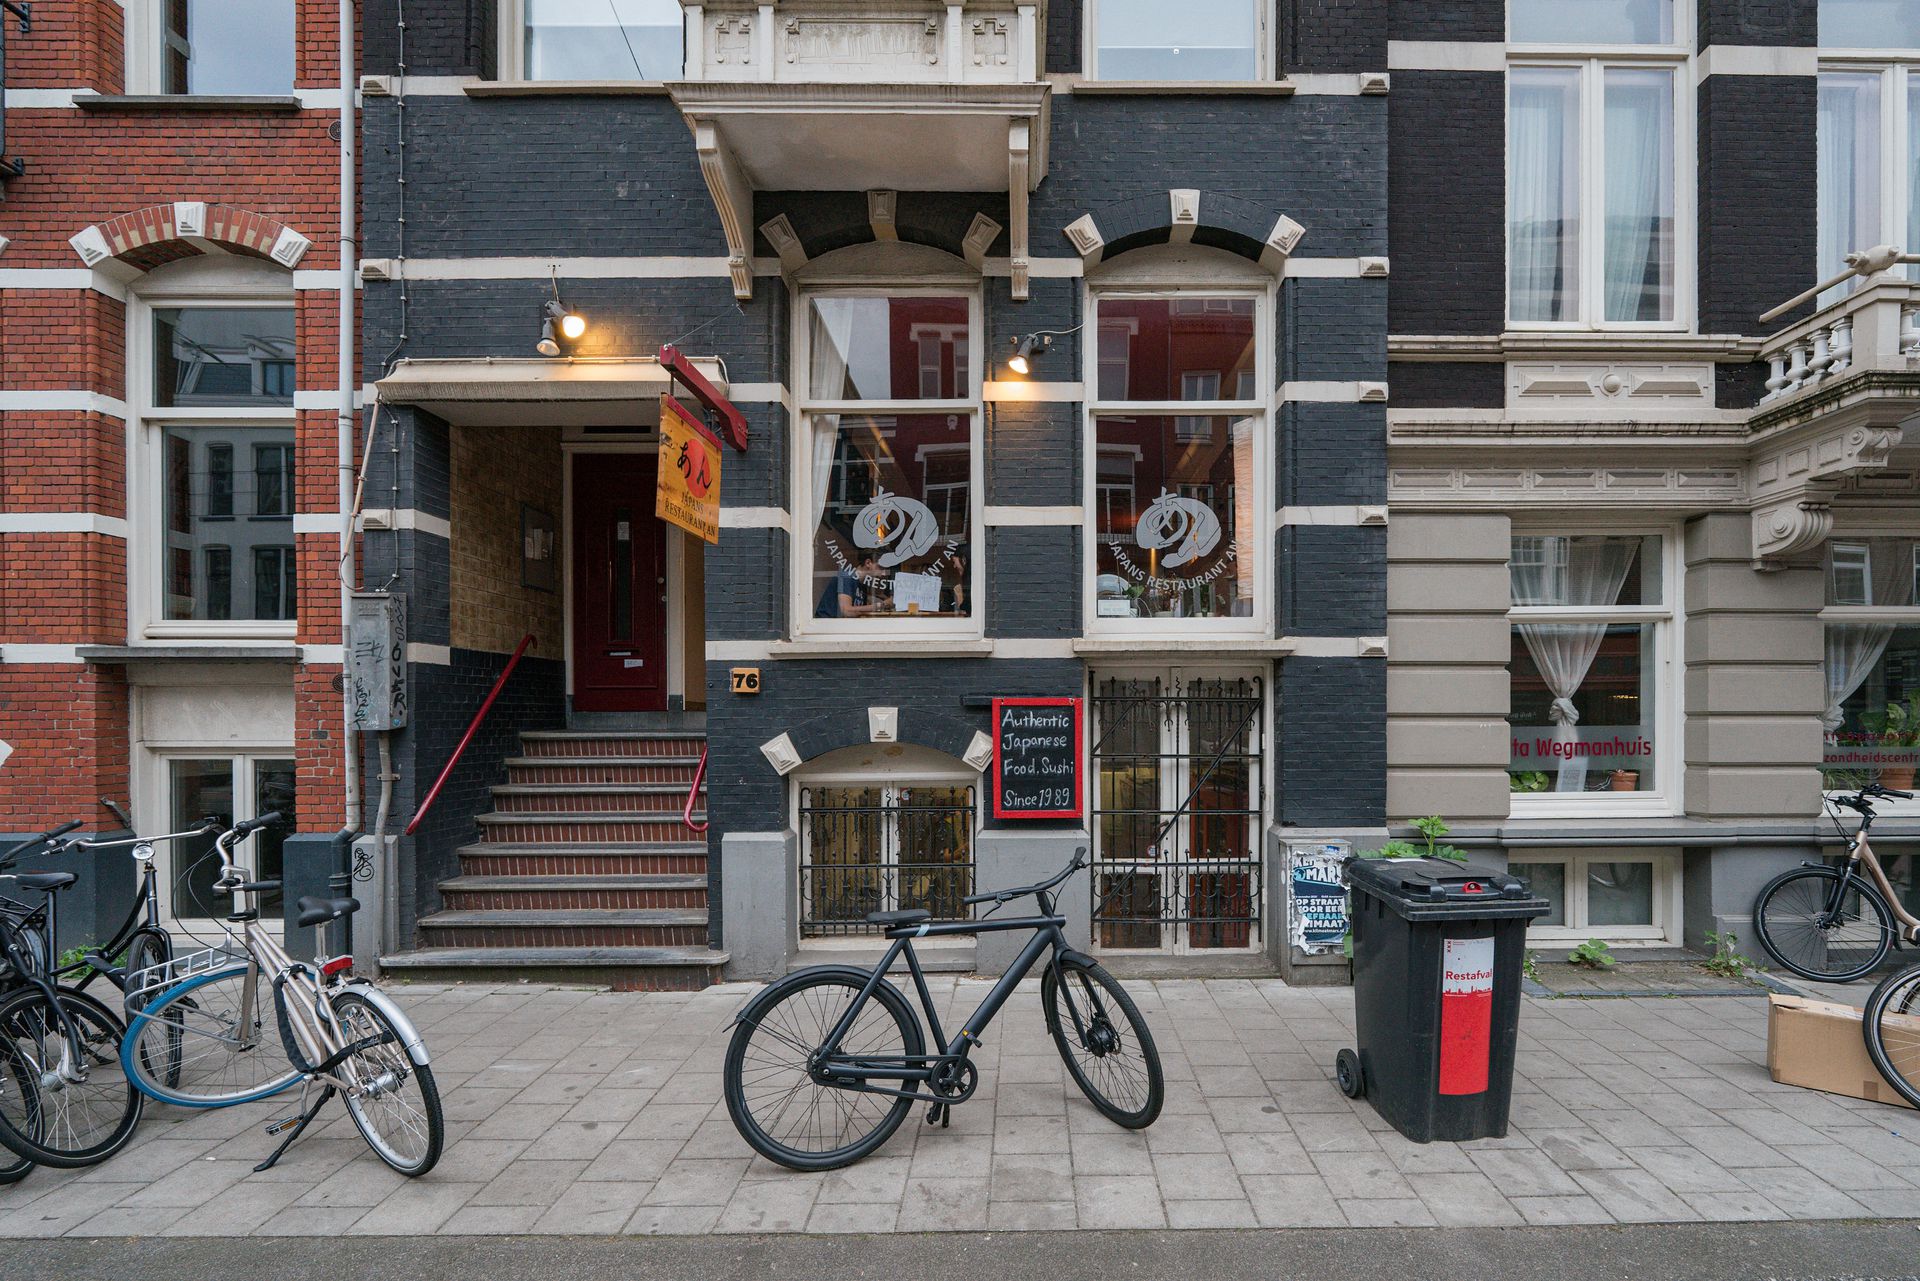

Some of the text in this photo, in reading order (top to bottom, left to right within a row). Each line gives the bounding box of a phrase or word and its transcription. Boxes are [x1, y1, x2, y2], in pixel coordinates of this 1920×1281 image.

[706, 525, 716, 538] AN
[824, 539, 860, 581] JAPANS
[943, 539, 959, 561] AN
[1108, 540, 1146, 582] JAPANS
[1146, 558, 1228, 592] RESTAURANT
[733, 673, 758, 689] 76
[1002, 709, 1070, 728] Authentic
[1002, 732, 1068, 756] Japanese
[1535, 735, 1652, 760] Wegmanhuis
[1041, 756, 1074, 775] Sushi
[1003, 787, 1070, 808] Since 1989
[1296, 898, 1310, 906] OP
